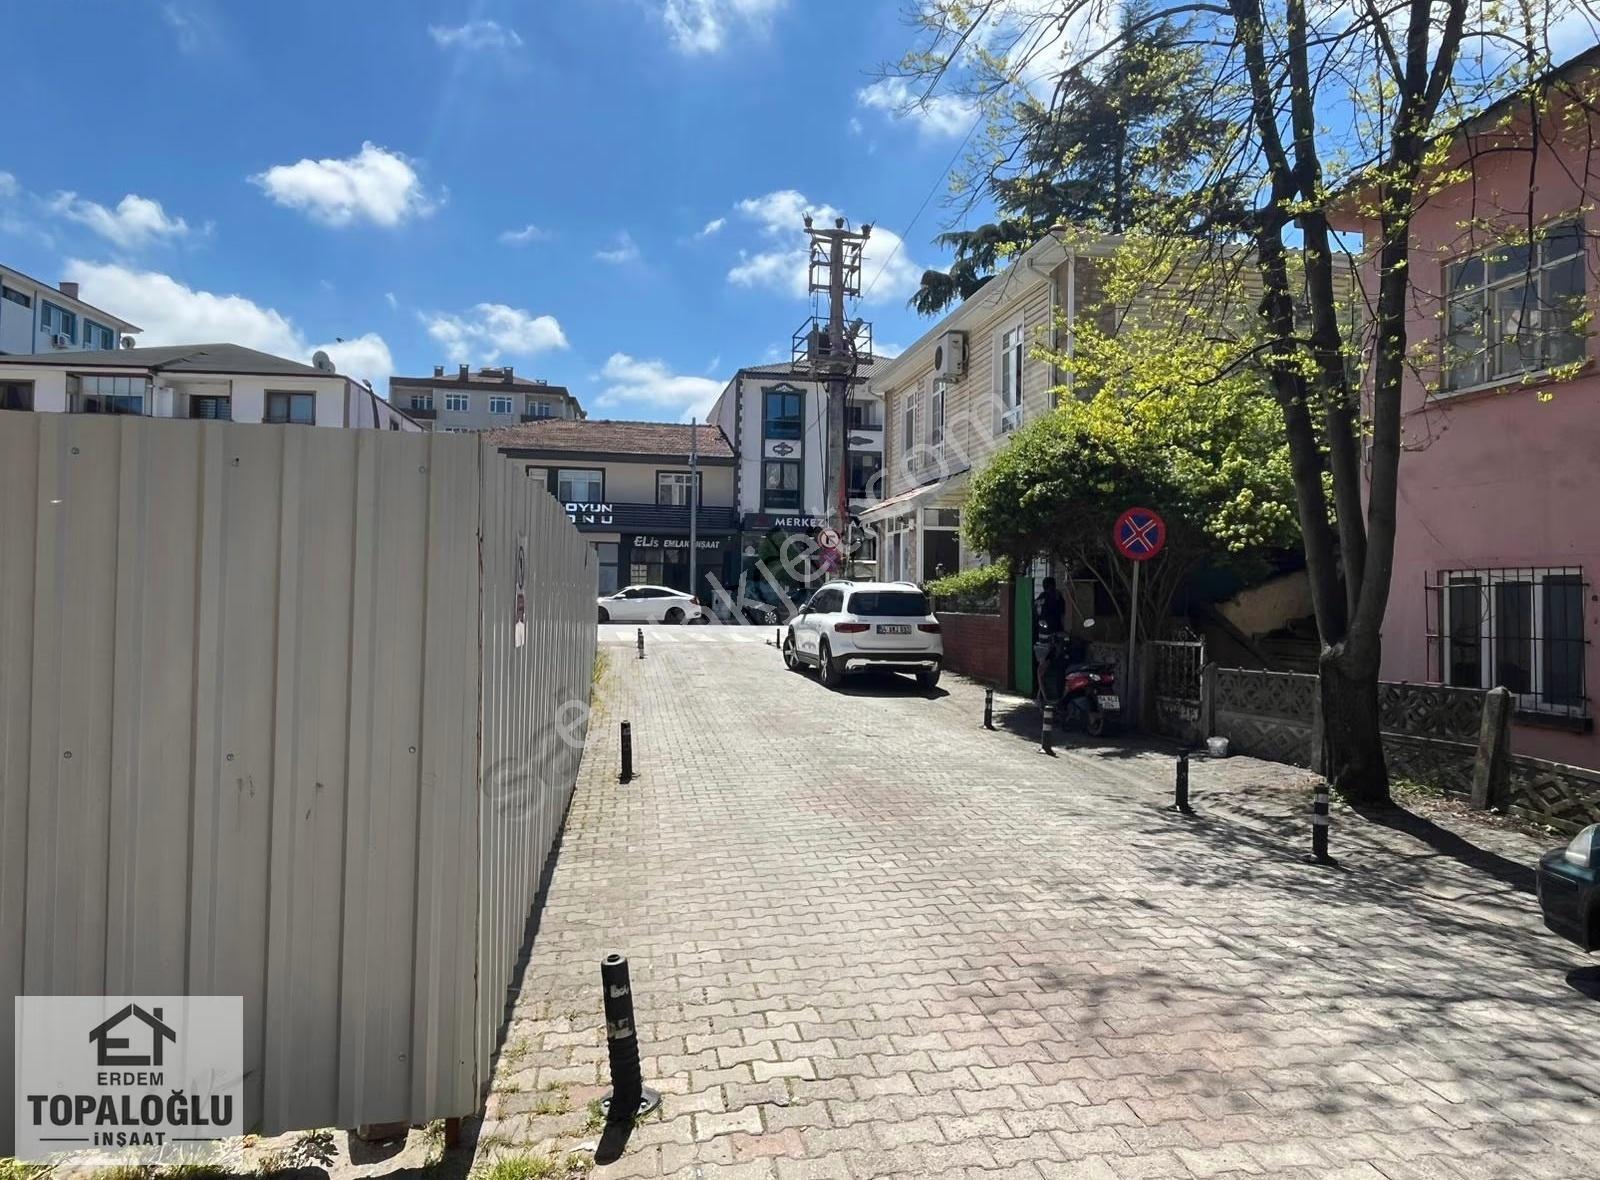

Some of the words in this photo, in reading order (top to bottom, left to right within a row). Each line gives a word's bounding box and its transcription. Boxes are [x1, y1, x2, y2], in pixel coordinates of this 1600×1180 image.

[565, 503, 613, 513] OYUN
[774, 517, 826, 528] MERKEZ
[663, 539, 690, 548] EMLAK
[695, 540, 720, 549] NŞAAT
